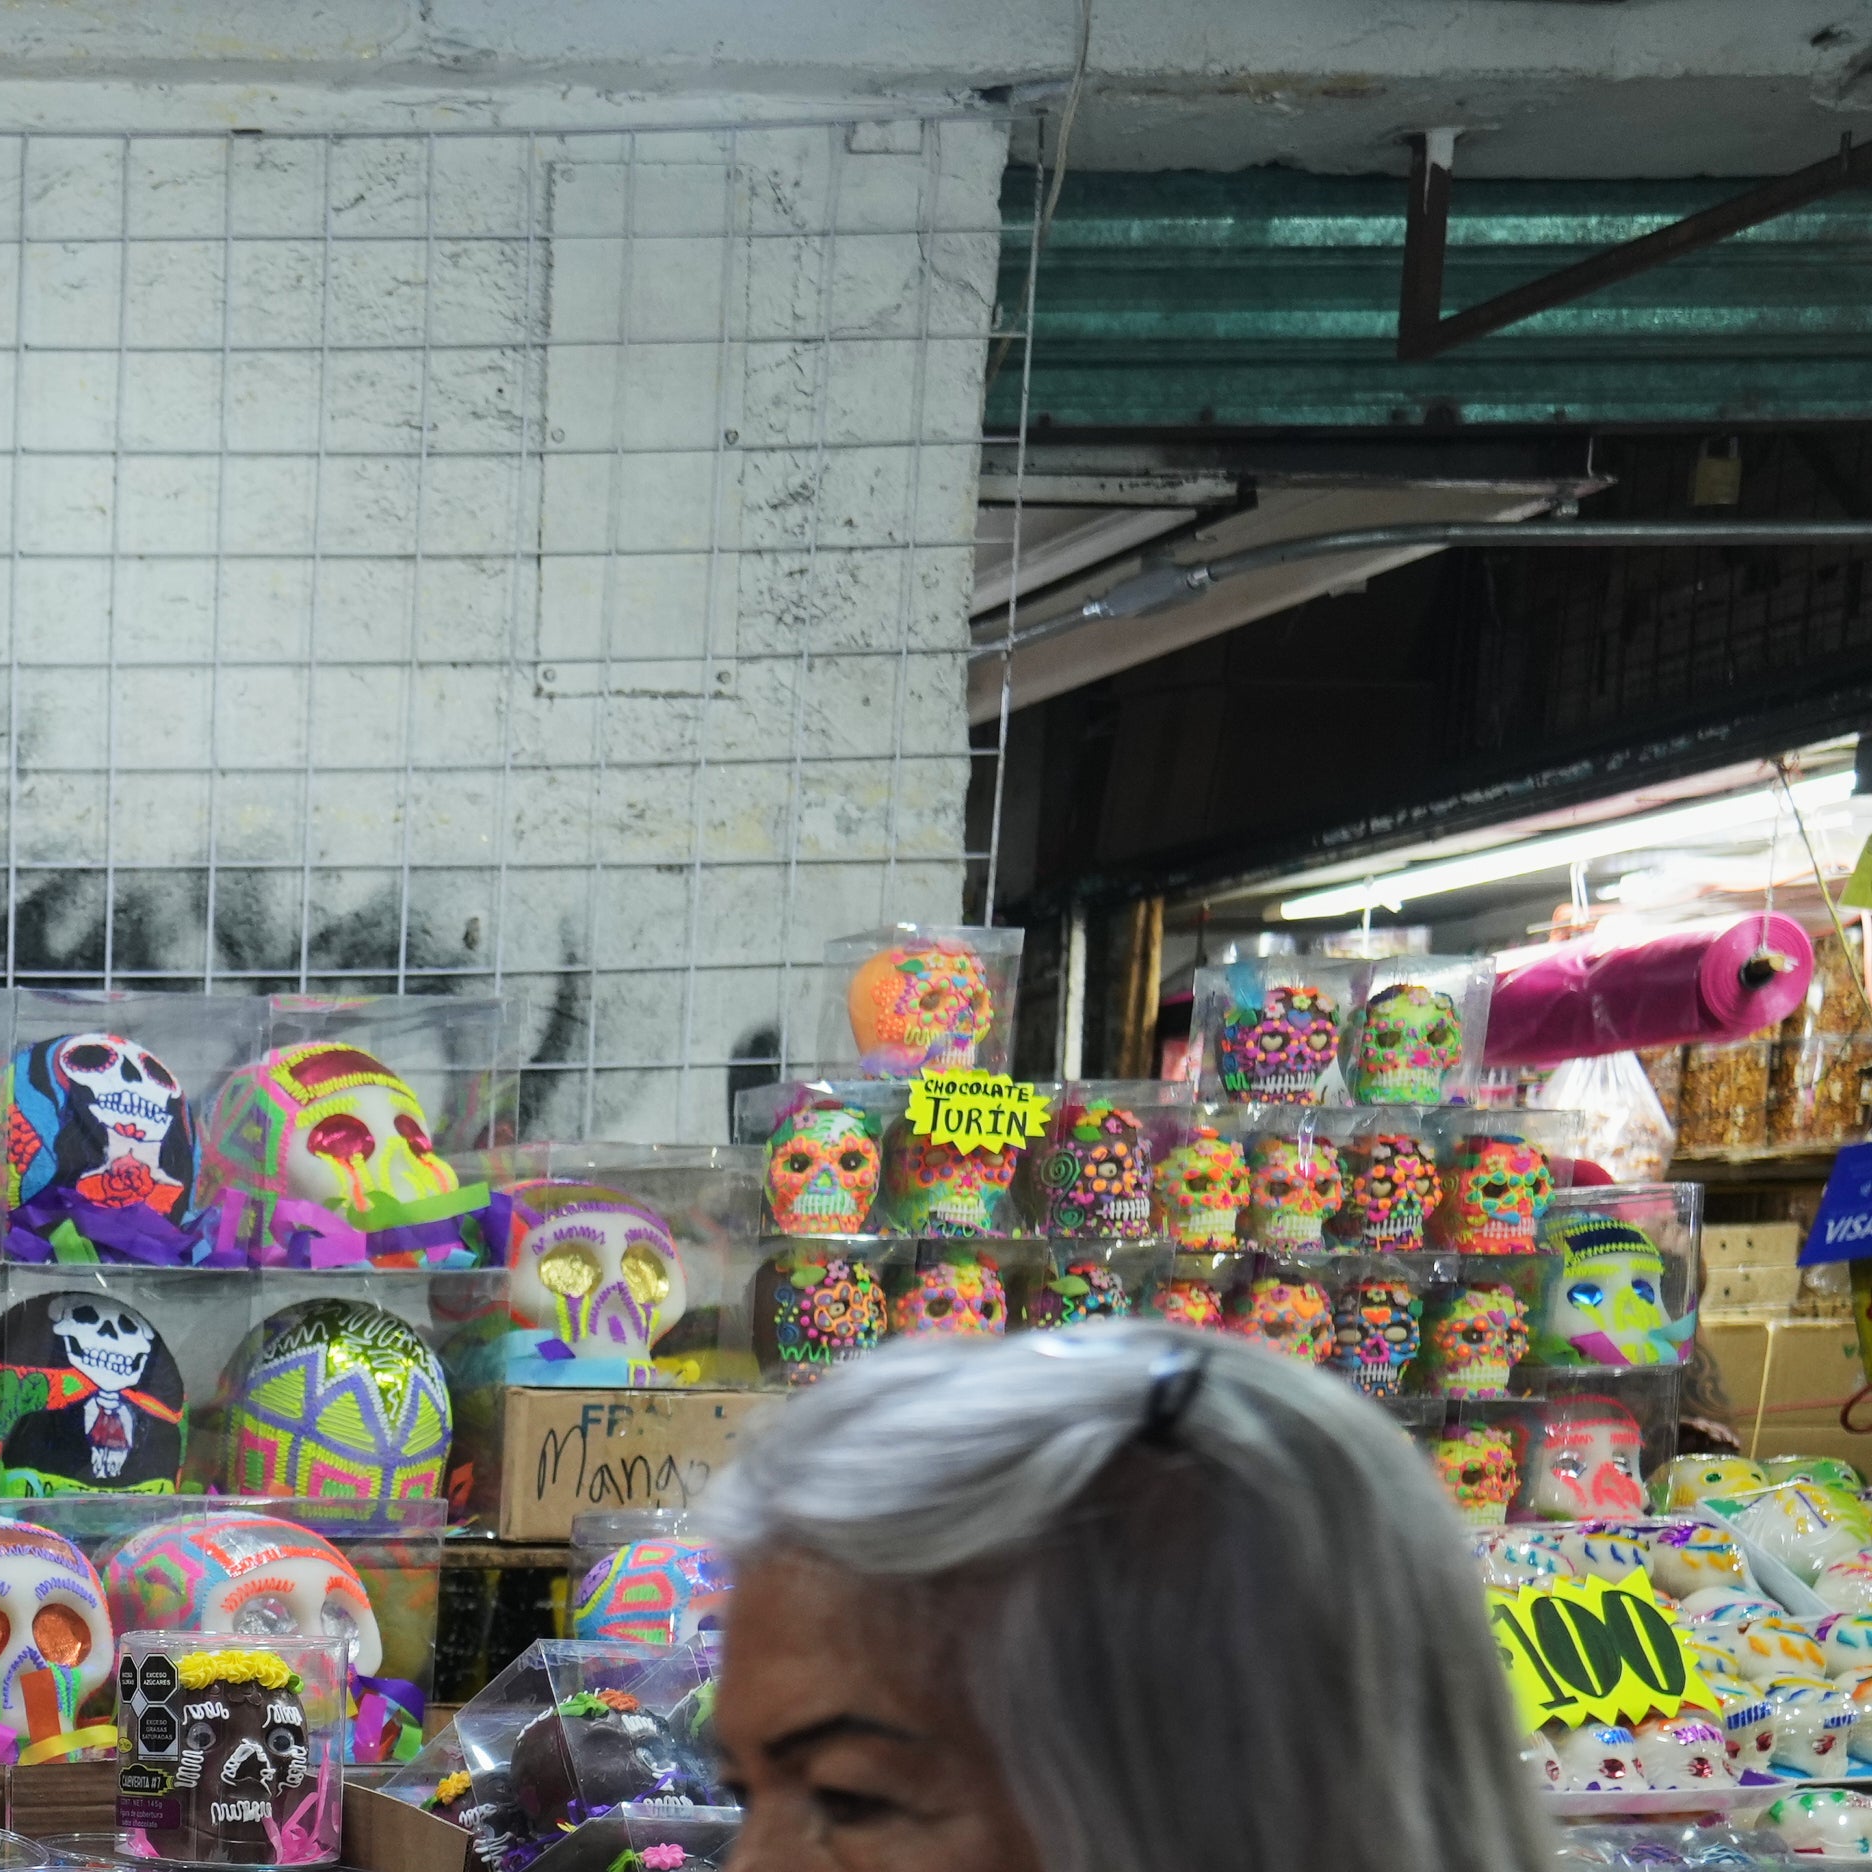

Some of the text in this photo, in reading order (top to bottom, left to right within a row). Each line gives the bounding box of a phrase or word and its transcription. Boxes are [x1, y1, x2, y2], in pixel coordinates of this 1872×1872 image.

[925, 1079, 1029, 1102] CHOCOLATE
[926, 1096, 1027, 1137] TURÍN
[143, 1678, 171, 1687] AZÚCARES
